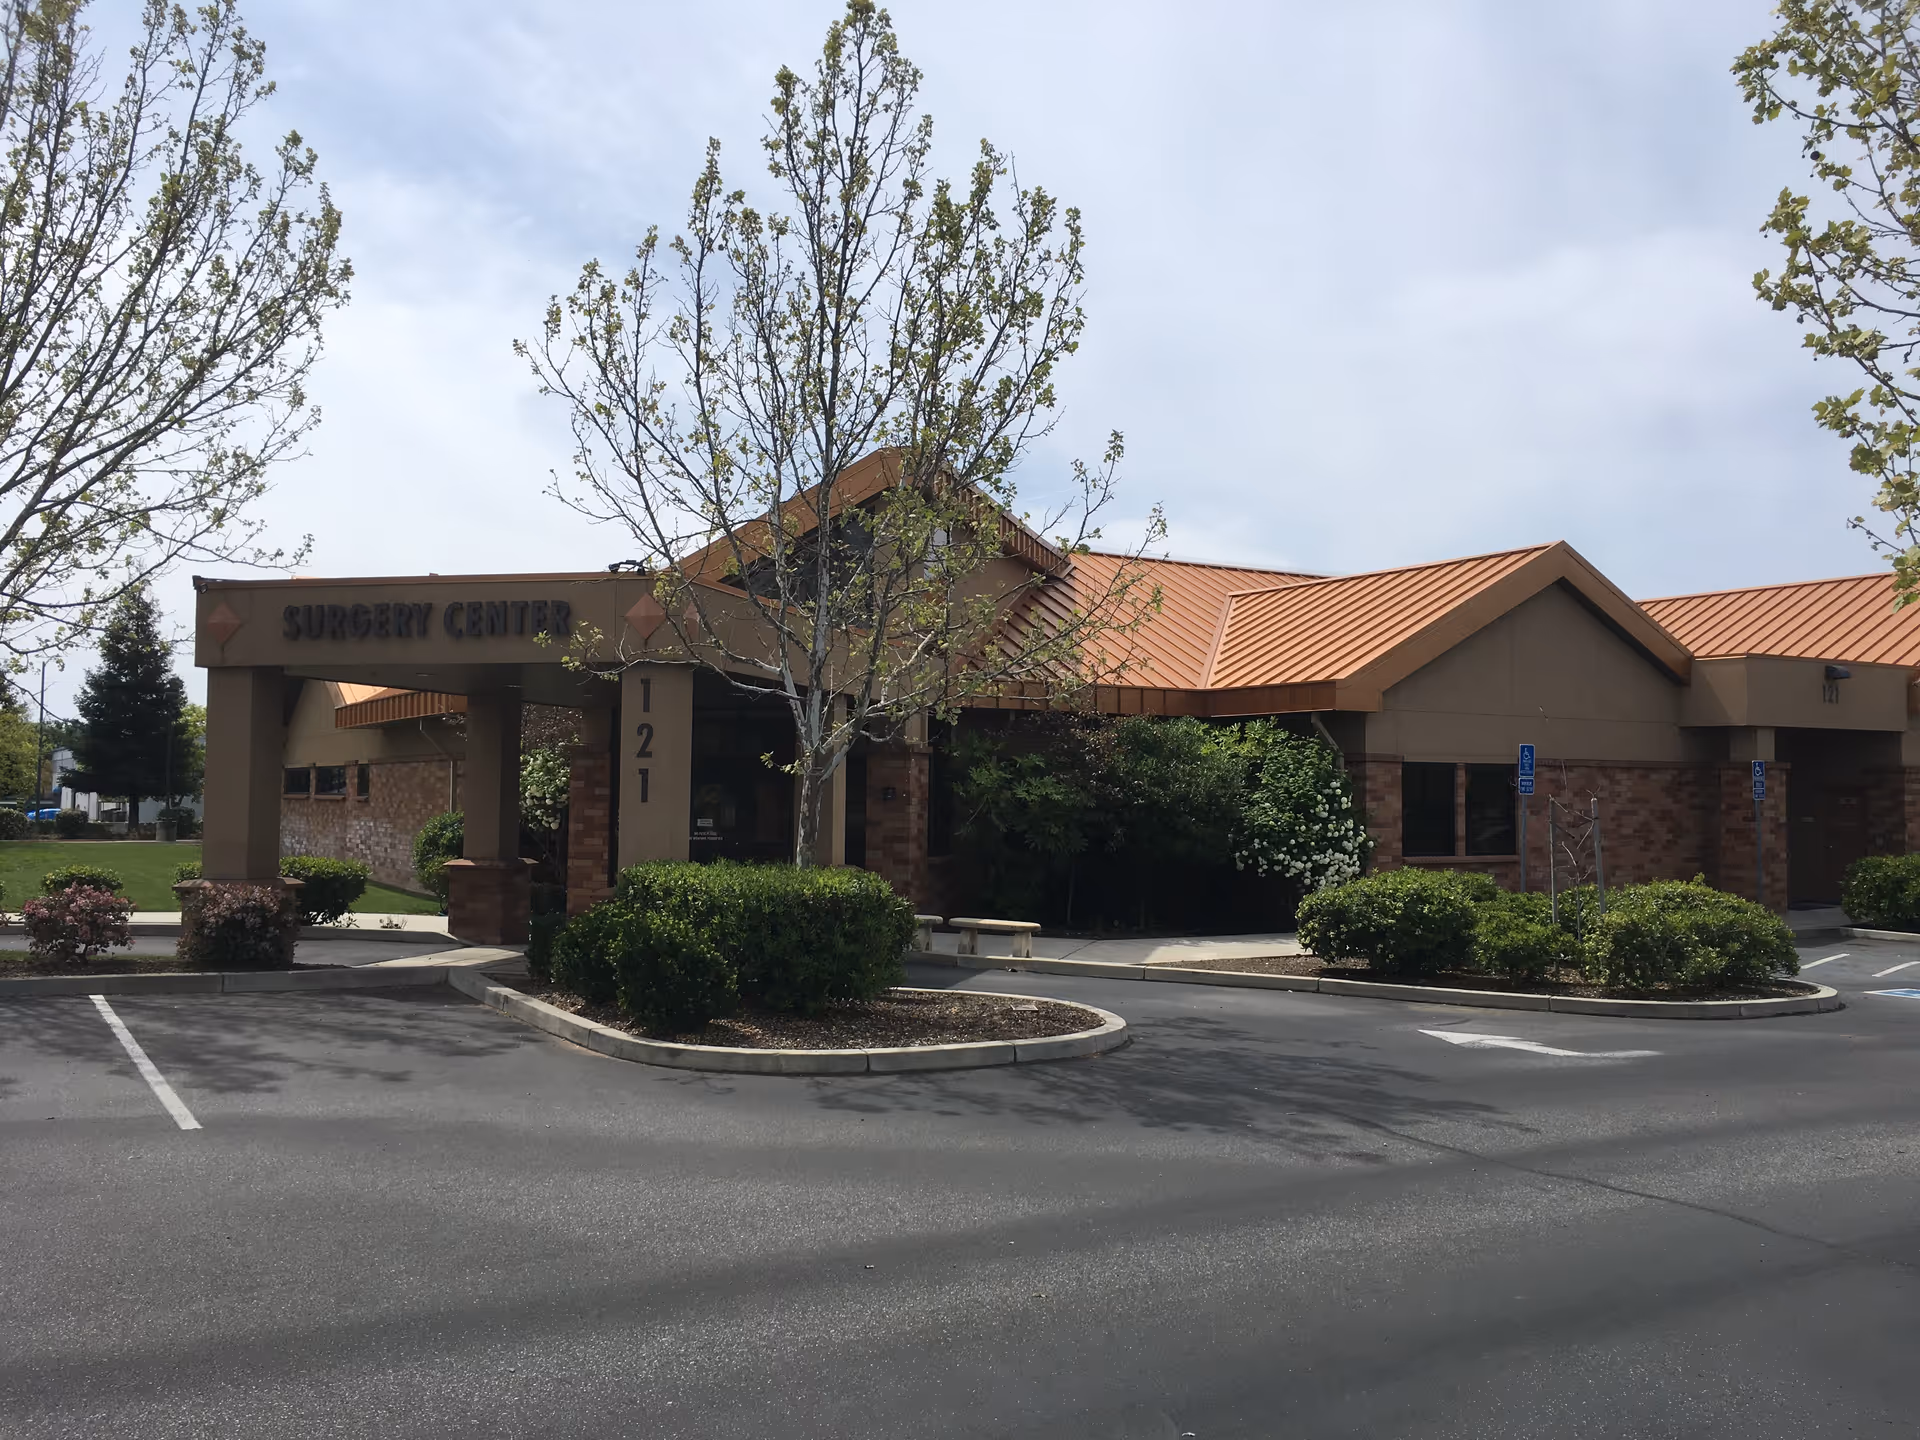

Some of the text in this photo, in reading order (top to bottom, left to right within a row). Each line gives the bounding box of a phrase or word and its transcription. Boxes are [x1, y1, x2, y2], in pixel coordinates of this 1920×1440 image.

[282, 600, 571, 640] SURGERY CENTER
[1822, 683, 1840, 705] 121
[636, 678, 654, 803] 121
